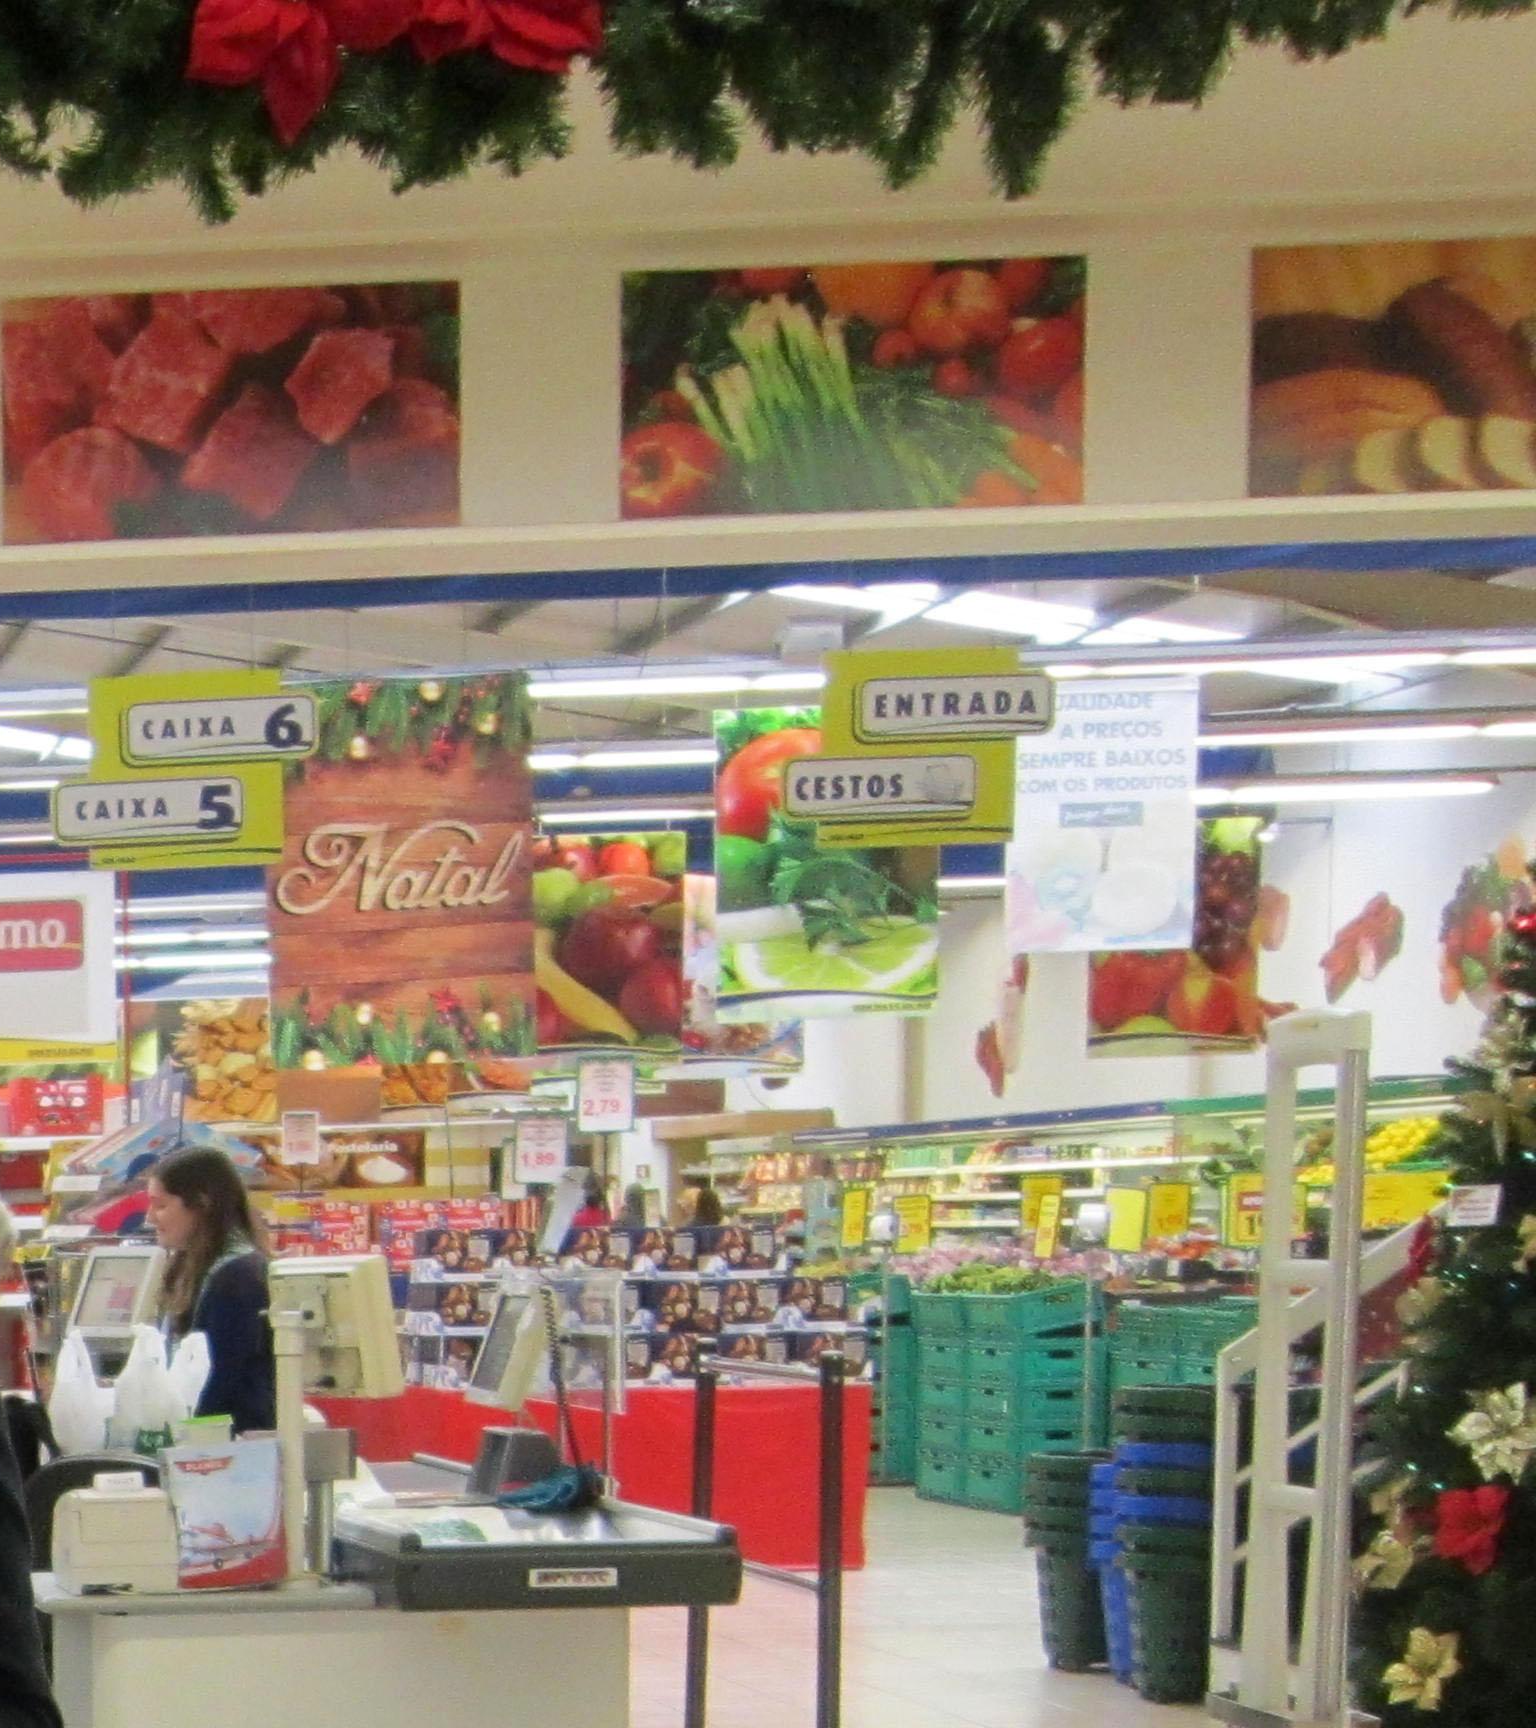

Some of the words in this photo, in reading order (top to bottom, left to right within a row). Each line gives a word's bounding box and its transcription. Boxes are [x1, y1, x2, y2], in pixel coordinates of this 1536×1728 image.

[874, 689, 1036, 718] ENTRADA
[141, 715, 235, 740] CAIXA
[264, 703, 303, 748] 6
[1060, 723, 1074, 740] A
[1018, 751, 1097, 770] SEMPRE
[1105, 748, 1187, 767] BAIXOS
[795, 773, 905, 801] CESTOS
[75, 796, 168, 821] CAIXA
[197, 784, 235, 829] 5
[276, 820, 524, 915] Natal
